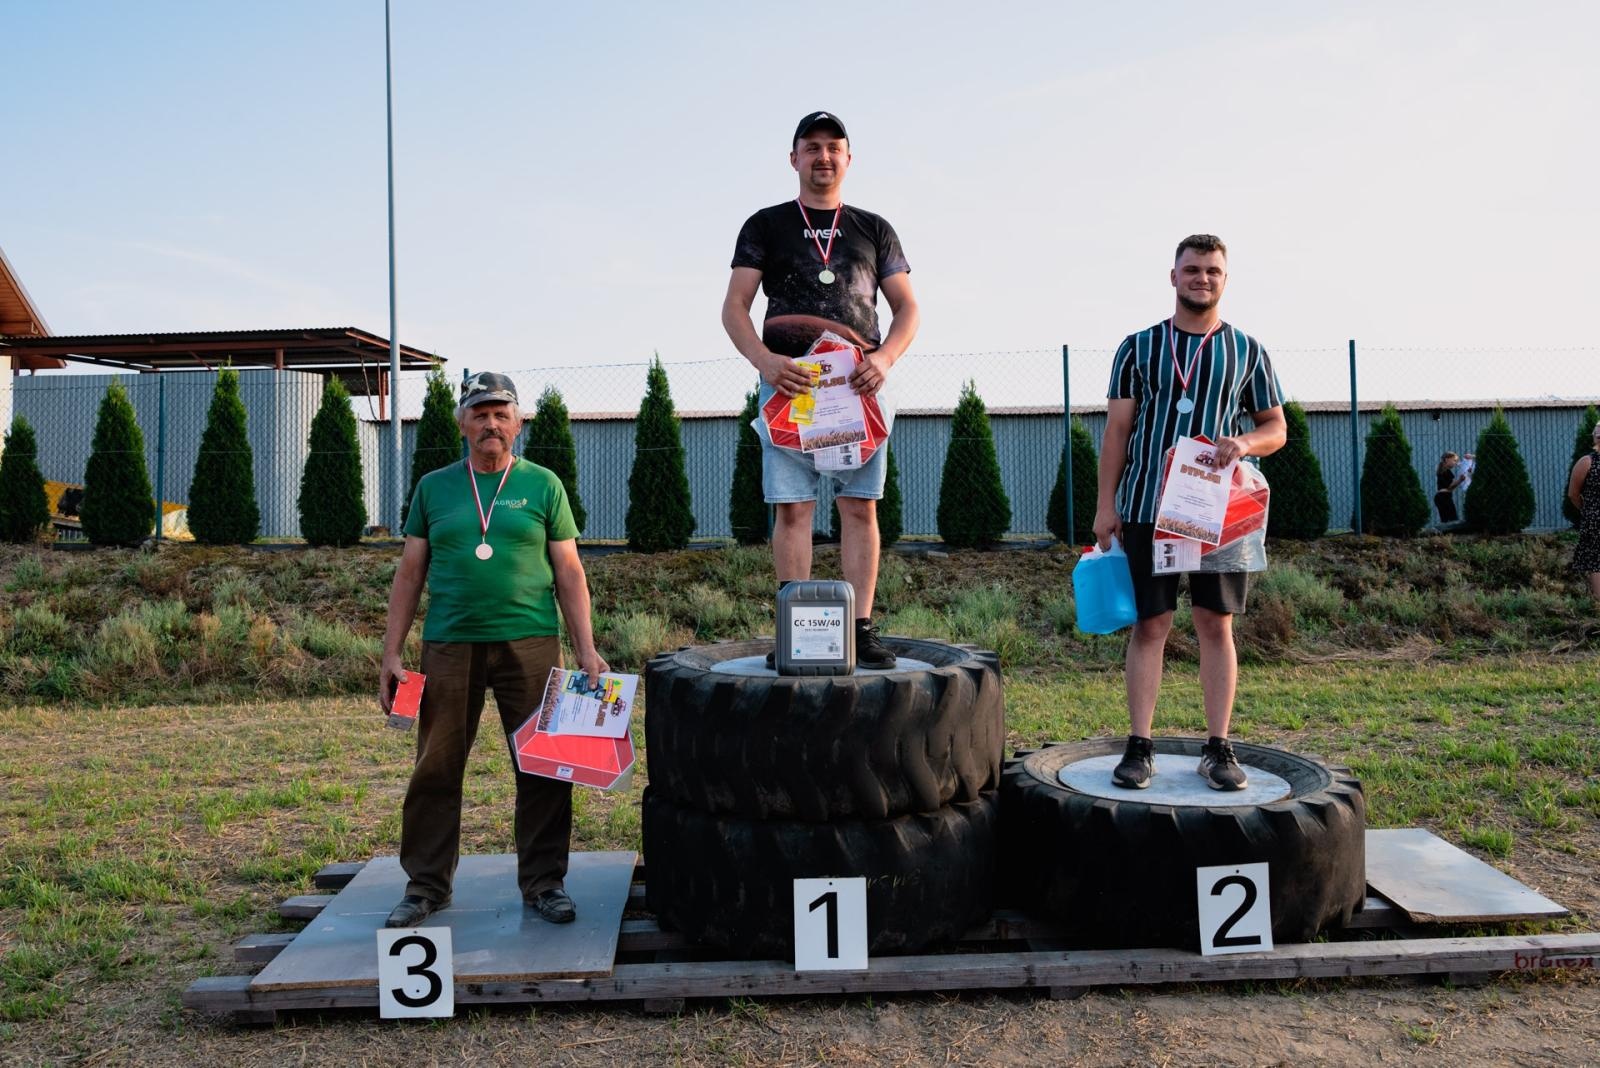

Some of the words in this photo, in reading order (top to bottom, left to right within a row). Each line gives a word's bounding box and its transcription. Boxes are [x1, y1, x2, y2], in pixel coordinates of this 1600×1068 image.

[803, 228, 842, 238] NASA
[1180, 463, 1222, 485] DYPLOM
[793, 619, 805, 627] CC
[808, 619, 841, 628] 15W/40
[808, 891, 839, 959] 1
[1210, 875, 1261, 948] 2
[389, 935, 443, 1008] 3
